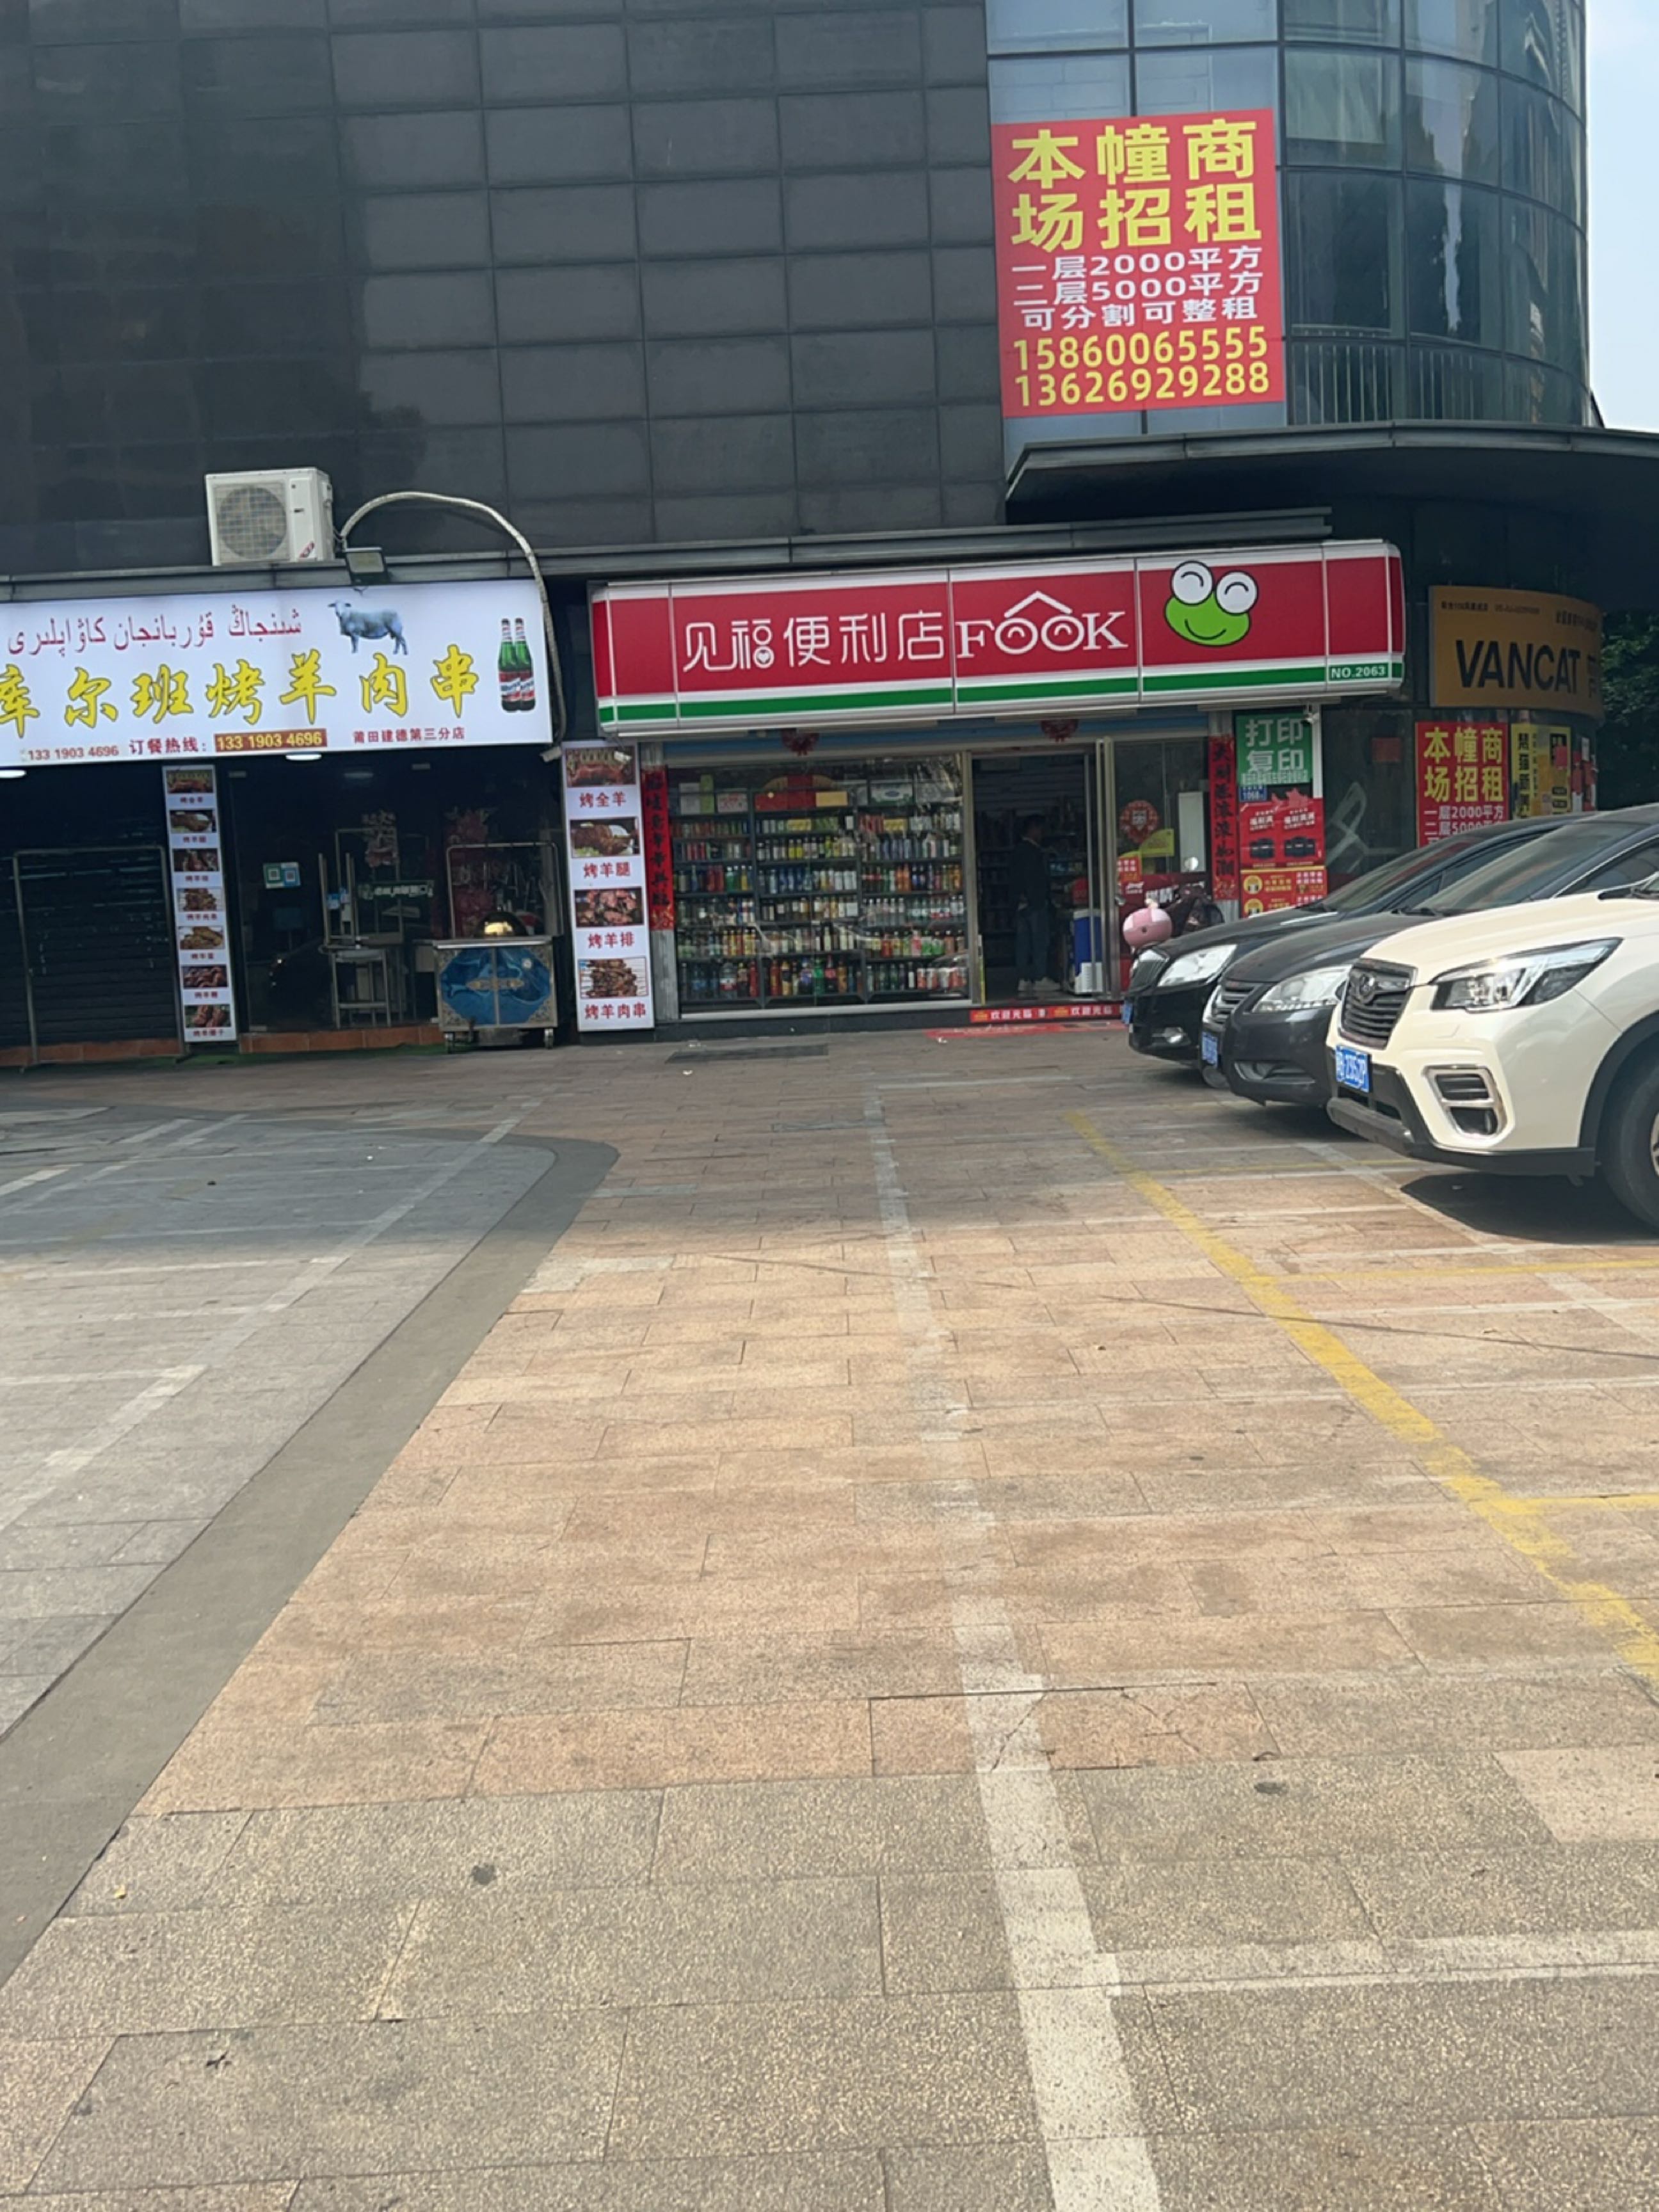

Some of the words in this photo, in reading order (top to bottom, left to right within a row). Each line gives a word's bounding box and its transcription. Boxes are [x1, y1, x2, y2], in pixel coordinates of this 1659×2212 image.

[1008, 119, 1256, 189] 本幢商
[1011, 182, 1262, 253] 场招租
[1012, 246, 1262, 280] 一层2000平方
[1014, 271, 1263, 306] 二层5000平方
[1022, 297, 1258, 332] 可分割可整租
[1014, 326, 1268, 371] 15860065555
[1015, 361, 1270, 407] 13626929288
[684, 609, 945, 673] 见福便利店
[956, 602, 1128, 661] FOOK
[1331, 666, 1386, 678] NO.2063
[1455, 639, 1581, 695] VANCAT
[216, 735, 244, 751] 133
[248, 732, 283, 748] 1903
[286, 730, 323, 747] 4696
[353, 726, 465, 744] 莆田建德第三分店
[1245, 718, 1303, 747] 打印
[1424, 726, 1503, 764] 本幢商
[28, 749, 51, 761] 133
[55, 748, 84, 760] 1903
[1248, 749, 1304, 773] 复印
[579, 791, 627, 809] 烤全羊
[1424, 766, 1504, 803] 场招租
[583, 861, 631, 879] 烤羊腿
[588, 931, 635, 950] 烤羊排
[584, 1001, 647, 1021] 烤羊肉串
